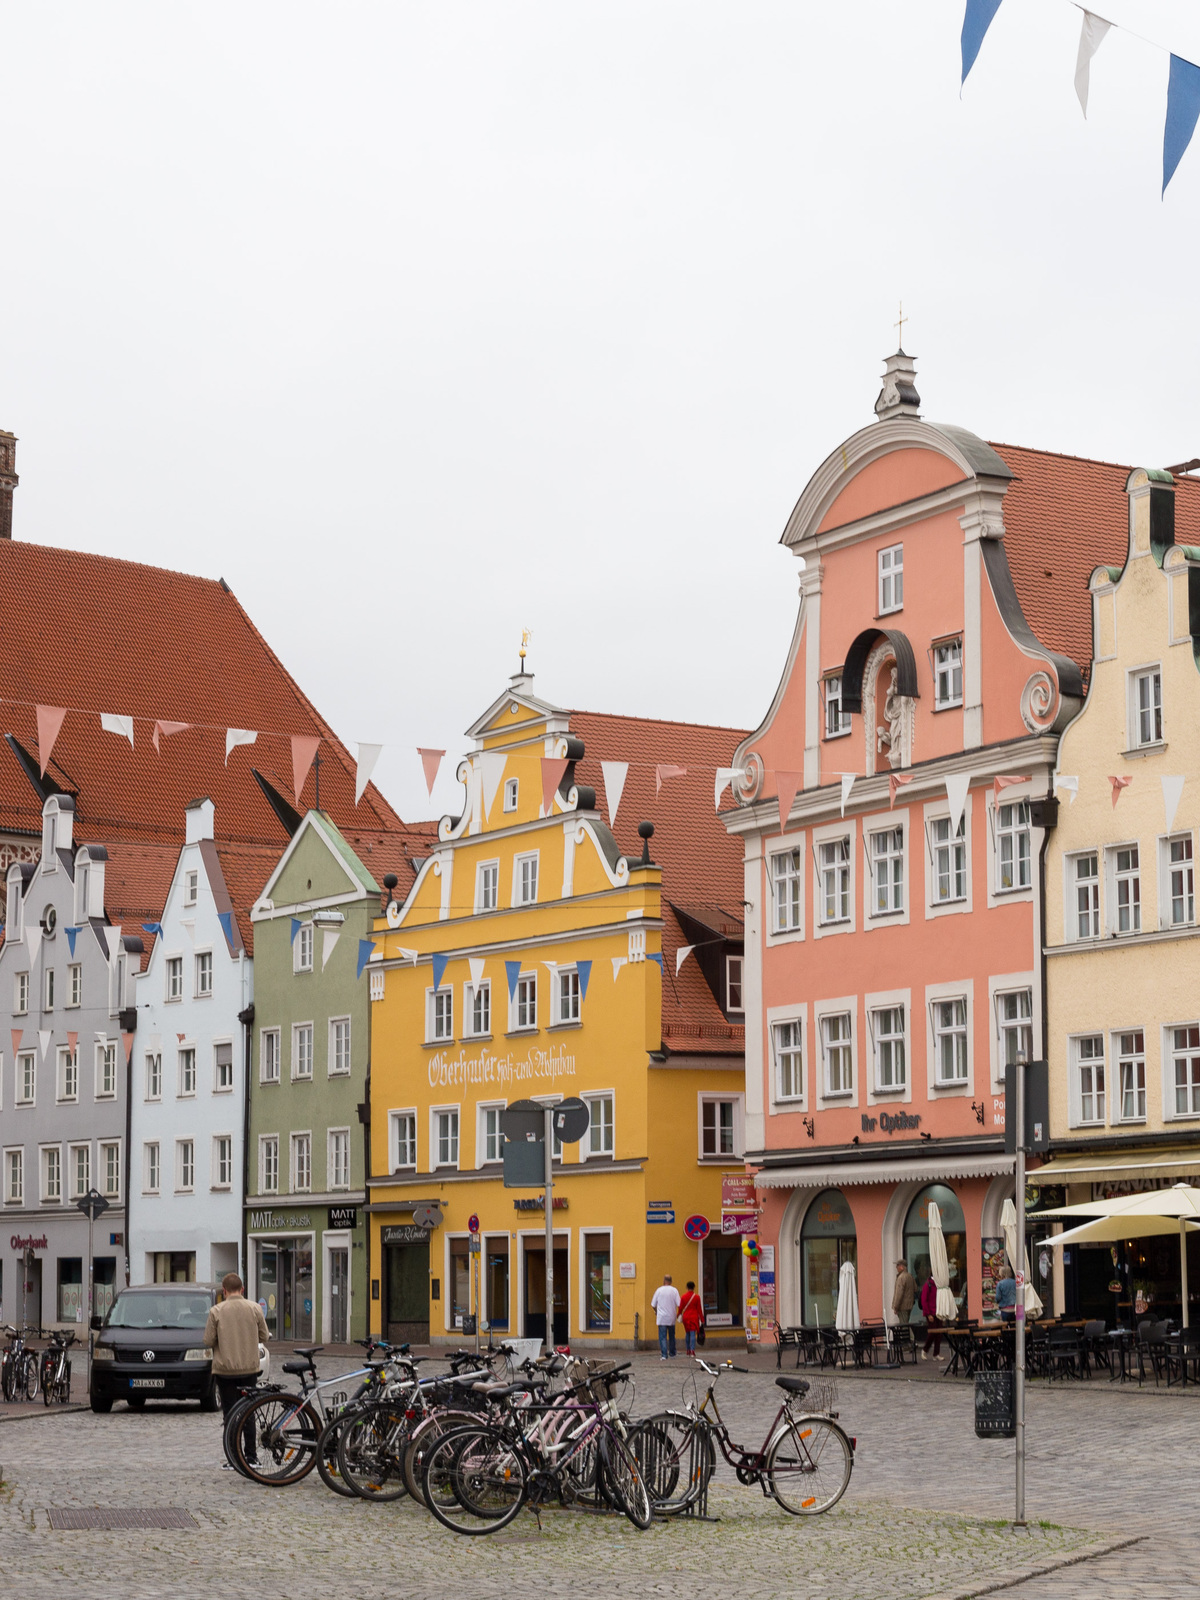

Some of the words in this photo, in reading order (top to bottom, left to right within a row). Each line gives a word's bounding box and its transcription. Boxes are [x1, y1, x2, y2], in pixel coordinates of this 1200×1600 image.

[861, 1113, 877, 1133] Ihr
[879, 1110, 922, 1135] Optiker
[331, 1209, 355, 1219] MATT
[817, 1211, 841, 1224] Optiker
[333, 1218, 353, 1230] optik
[10, 1234, 48, 1250] Oberbank
